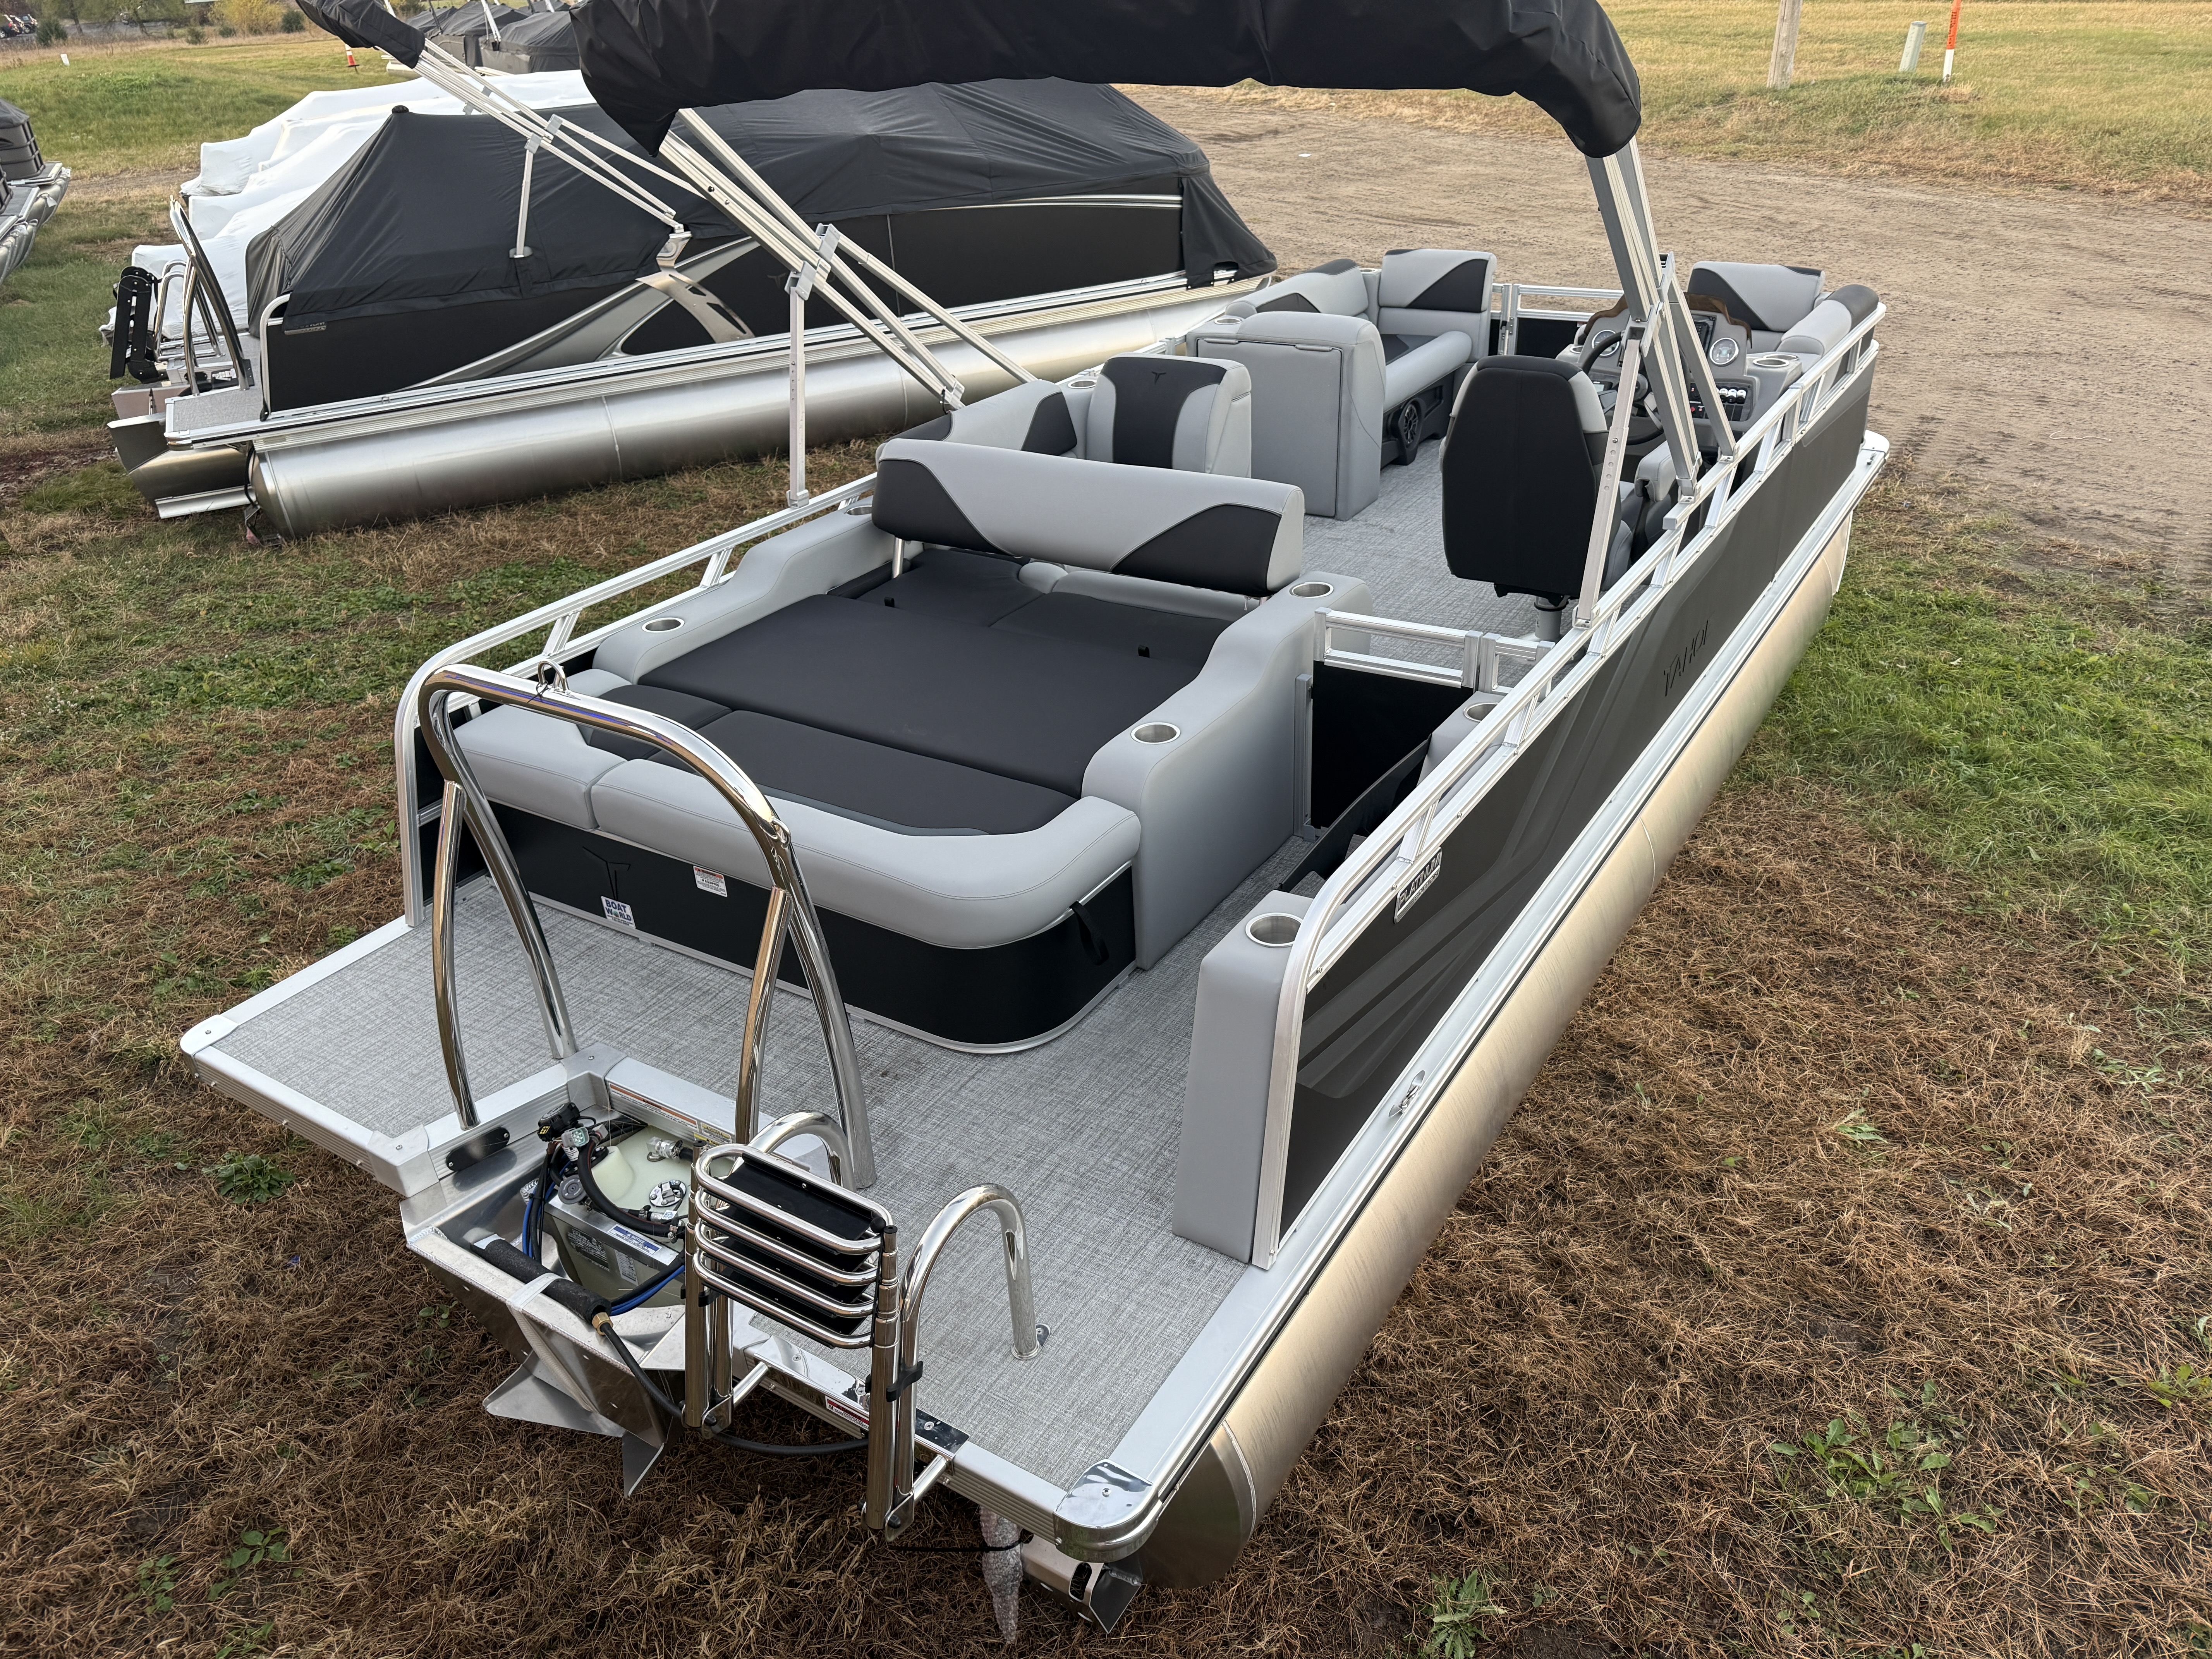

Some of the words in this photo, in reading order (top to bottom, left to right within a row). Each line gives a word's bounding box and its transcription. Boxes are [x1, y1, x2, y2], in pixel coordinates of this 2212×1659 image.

[1399, 852, 1441, 909] PLATINUM
[605, 899, 627, 913] BOAT
[605, 907, 632, 921] WORLD
[631, 1234, 645, 1244] NOTICE
